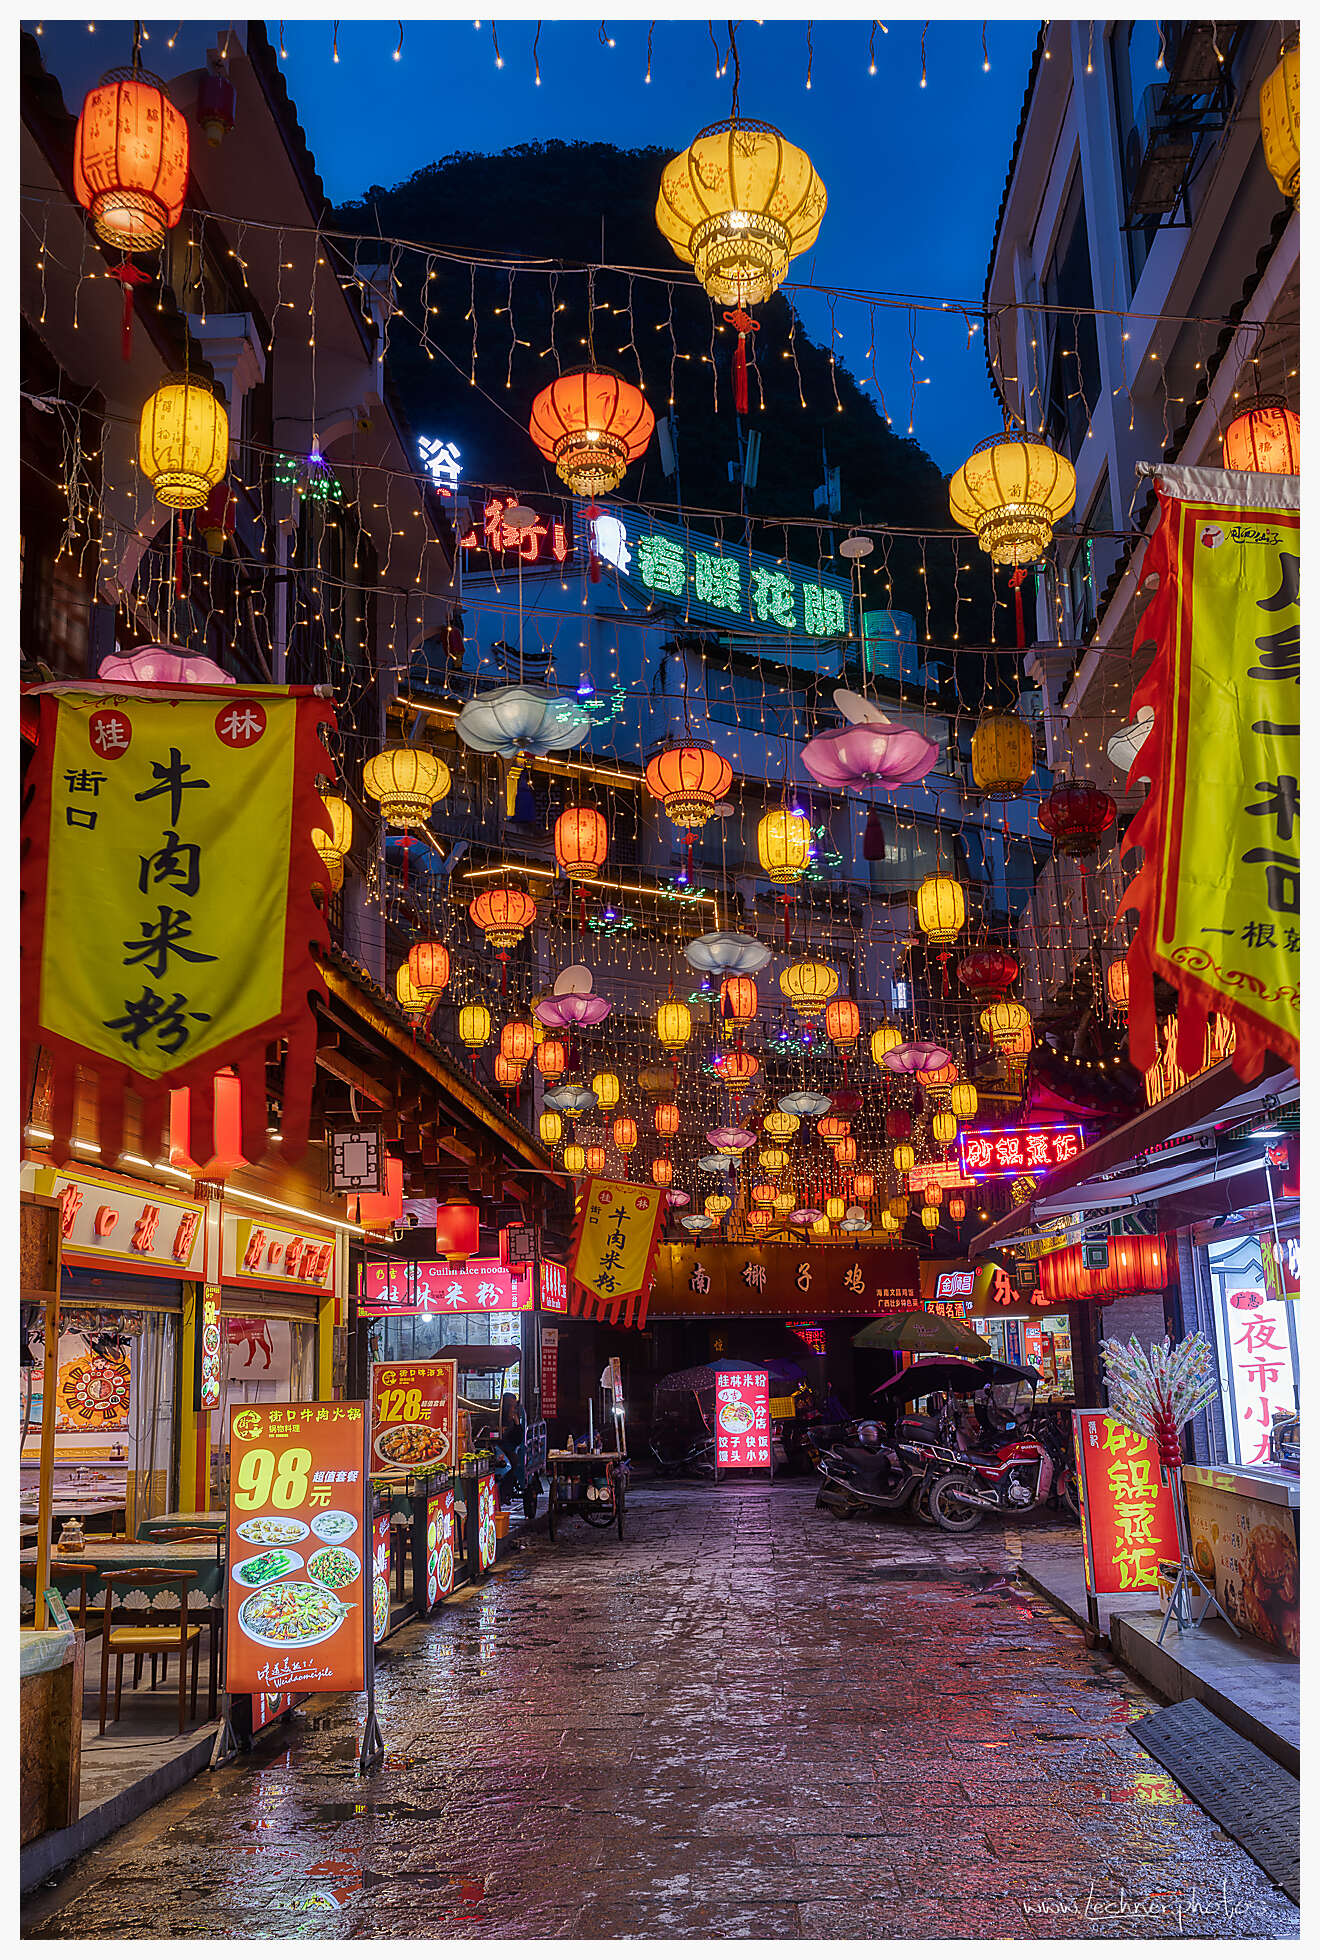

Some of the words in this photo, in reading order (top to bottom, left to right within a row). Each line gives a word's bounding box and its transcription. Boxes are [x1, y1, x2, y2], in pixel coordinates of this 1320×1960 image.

[418, 436, 463, 490] 浴
[460, 498, 547, 560] 街
[64, 767, 108, 831] 街口
[103, 747, 219, 1055] 牛肉米粉
[966, 1134, 1077, 1168] 砂锅蒸饭
[593, 1205, 631, 1293] 牛肉米粉
[648, 1262, 866, 1295] 南椰子鸡
[376, 1281, 504, 1311] 桂林米粉
[927, 1303, 964, 1317] 名烟名酒
[718, 1373, 766, 1387] 桂林米粉
[269, 1407, 361, 1422] 街口牛肉火锅
[377, 1388, 422, 1421] 128
[419, 1408, 431, 1420] 元
[755, 1394, 766, 1430] 二分店
[719, 1436, 740, 1448] 饺子
[746, 1435, 768, 1447] 快饭
[719, 1450, 741, 1462] 馒头
[747, 1450, 768, 1462] 小炒
[234, 1447, 312, 1511] 98
[309, 1486, 332, 1507] 元
[312, 1471, 359, 1482] 超值套餐
[1102, 1418, 1162, 1589] 砂锅蒸饭
